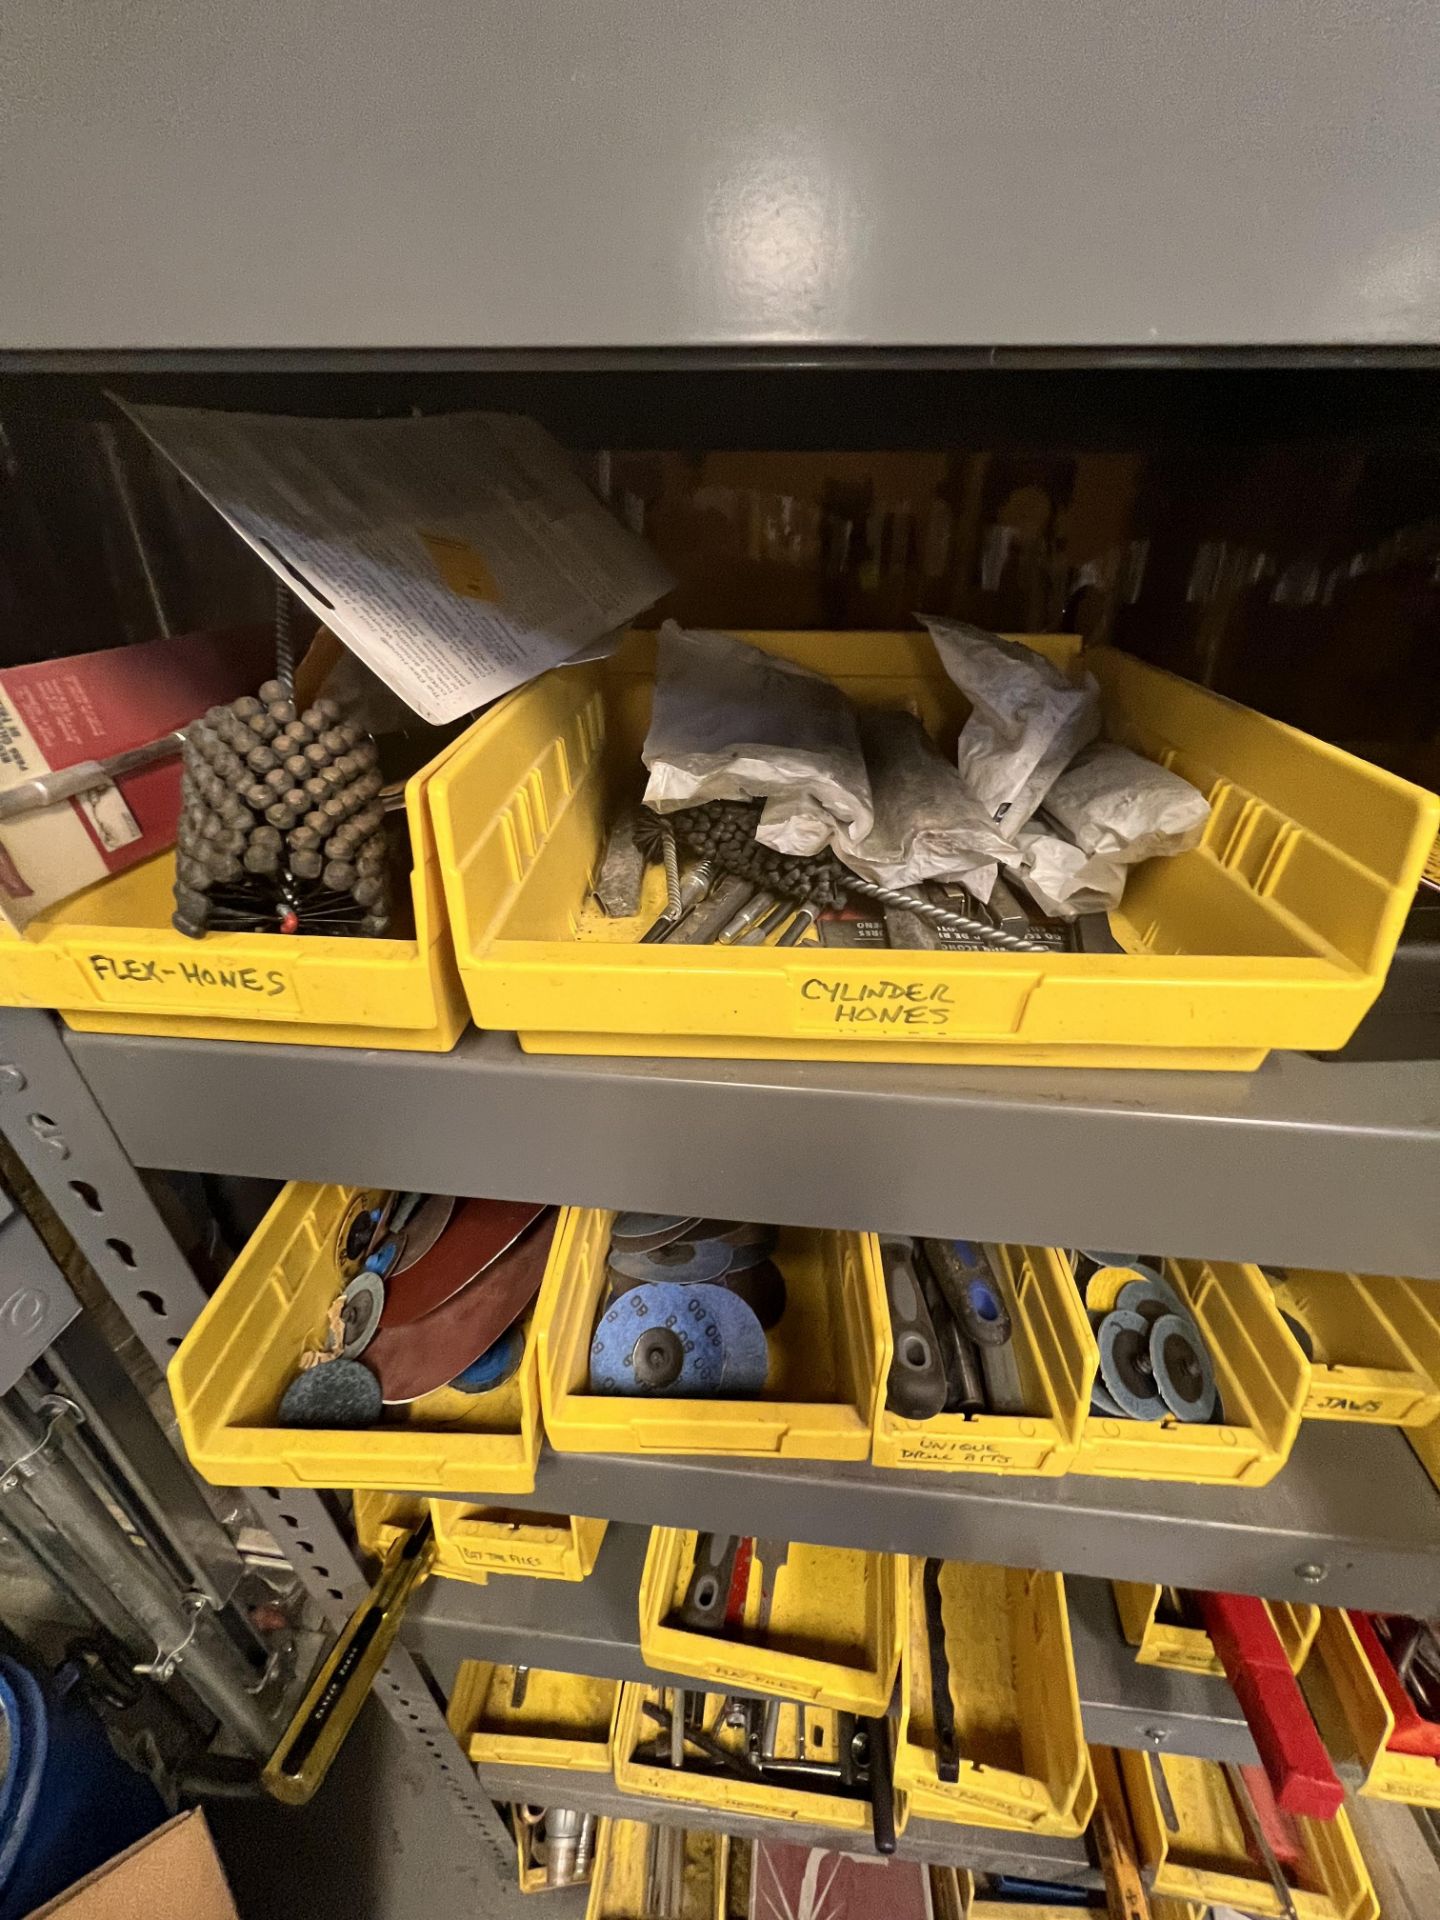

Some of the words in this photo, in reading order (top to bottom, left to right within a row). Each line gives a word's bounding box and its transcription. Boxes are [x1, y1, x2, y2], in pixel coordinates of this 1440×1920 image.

[90, 955, 286, 996] FLEX-HONES
[801, 978, 955, 1003] CYLINDER
[835, 1004, 950, 1025] HONES
[919, 1436, 1001, 1453] UNIQUE
